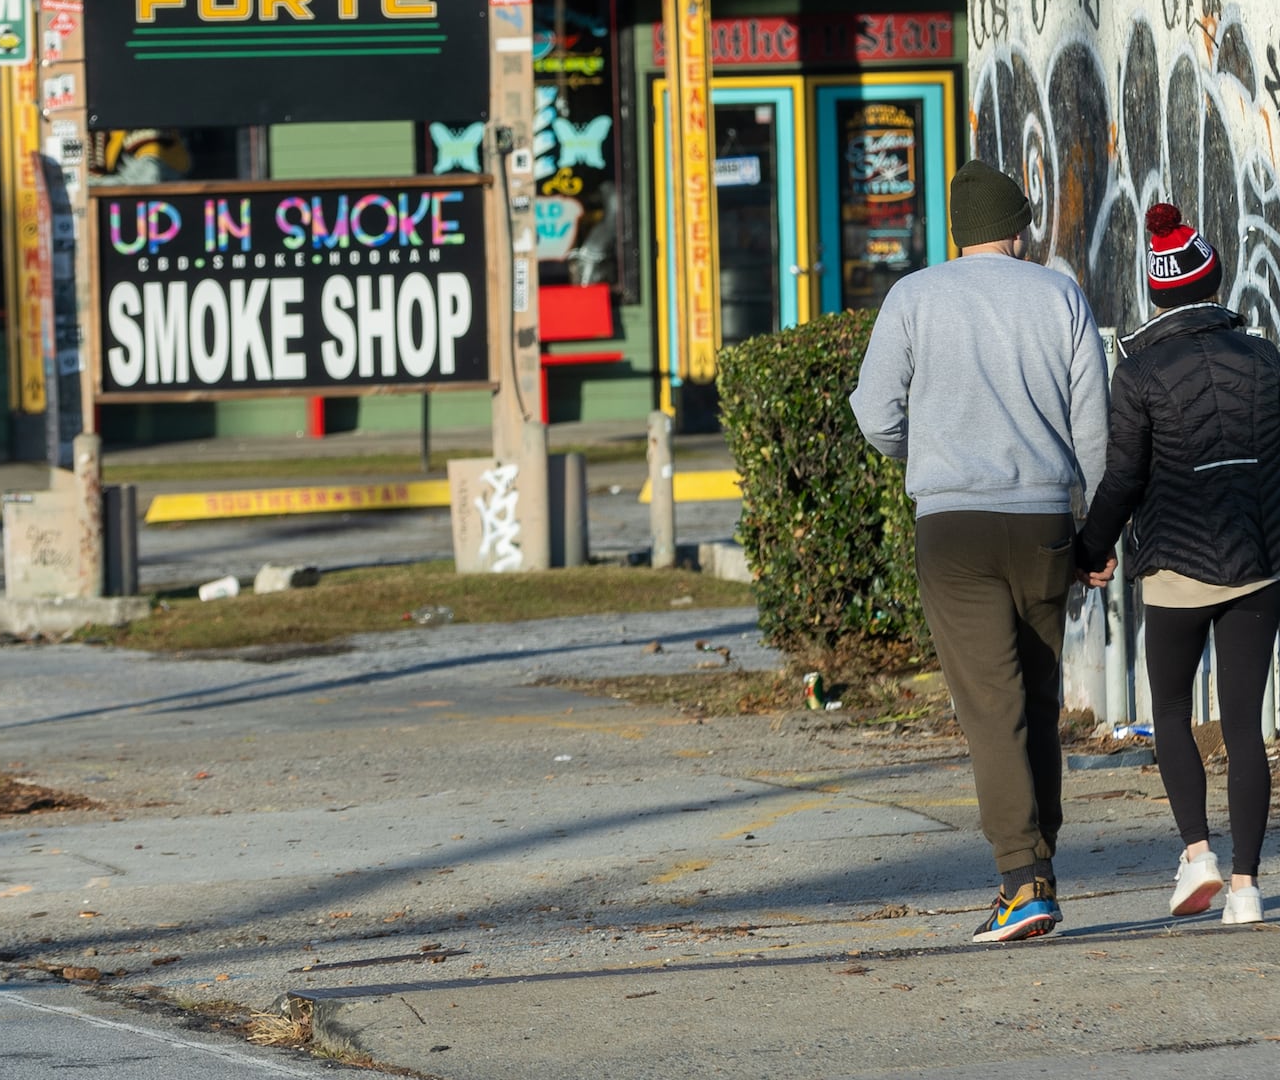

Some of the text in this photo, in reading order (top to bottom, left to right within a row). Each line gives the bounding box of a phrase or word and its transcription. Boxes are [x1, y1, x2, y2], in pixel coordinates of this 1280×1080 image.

[109, 190, 466, 255] UP IN SMOKE
[138, 256, 190, 272] CBD
[212, 252, 306, 270] SMOKE
[108, 277, 307, 387] SMOKE
[321, 272, 472, 380] SHOP
